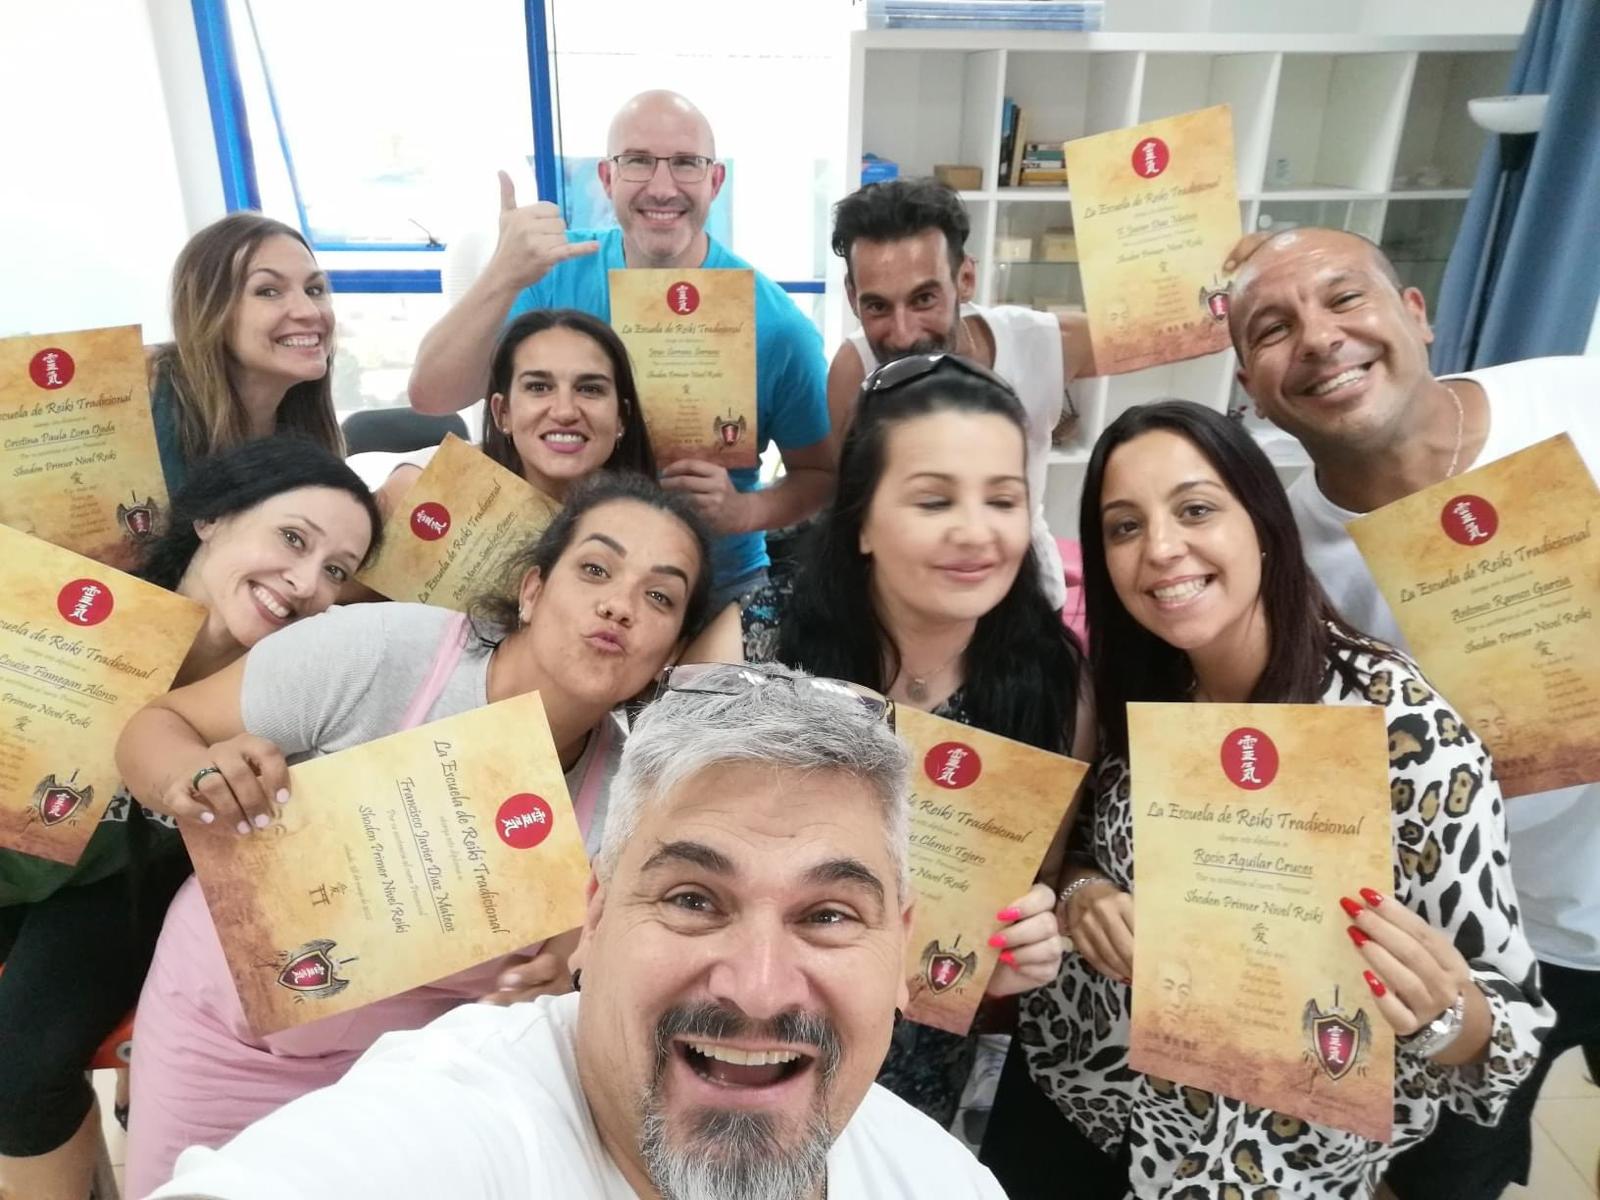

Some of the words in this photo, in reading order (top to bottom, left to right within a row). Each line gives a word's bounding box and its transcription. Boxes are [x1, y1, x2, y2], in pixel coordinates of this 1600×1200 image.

[1082, 206, 1096, 219] La
[1098, 197, 1131, 215] Escuela
[1130, 192, 1142, 206] de
[1170, 175, 1221, 197] Tradicional
[622, 324, 632, 334] La
[634, 322, 662, 333] Escuela
[674, 322, 696, 334] Reiki
[697, 321, 744, 334] Tradicional
[30, 402, 43, 416] de
[45, 398, 74, 414] Reiki
[76, 388, 133, 410] Tradicional
[96, 449, 117, 463] Reiki
[424, 560, 451, 592] Escuela
[444, 548, 458, 563] de
[452, 526, 474, 551] Reiki
[467, 478, 502, 528] Tradicional
[1398, 587, 1416, 603] La
[1416, 568, 1461, 596] Escuela
[1461, 562, 1476, 580] de
[1477, 550, 1513, 574] Reiki
[1513, 520, 1591, 562] Tradicional
[1498, 626, 1532, 644] Primer
[1533, 613, 1562, 633] Nivel
[1561, 605, 1593, 626] Reiki
[28, 626, 49, 642] de
[48, 632, 84, 657] Reiki
[85, 644, 160, 682] Tradicional
[31, 665, 82, 694] Finnegan
[81, 681, 119, 704] Alonso
[36, 702, 69, 721] Nivel
[64, 710, 92, 729] Reiki
[433, 738, 453, 758] La
[440, 759, 471, 807] Escuela
[358, 805, 381, 842] Shoden
[455, 808, 476, 824] de
[918, 798, 956, 820] Reiki
[956, 808, 1033, 844] Tradicional
[1147, 801, 1164, 817] La
[1168, 802, 1214, 821] Escuela
[1217, 806, 1232, 824] de
[1236, 808, 1274, 829] Reiki
[1277, 812, 1362, 836] Tradicional
[370, 842, 388, 878] Primer
[400, 777, 423, 831] Francisco
[412, 830, 433, 866] Javier
[435, 892, 455, 934] Mateos
[461, 826, 487, 861] Reiki
[1226, 852, 1273, 875] Aguilar
[1275, 857, 1314, 875] Cruces
[381, 878, 404, 908] Nivel
[473, 862, 511, 933] Tradicional
[943, 873, 970, 893] Reiki
[390, 906, 412, 934] Reiki
[1184, 888, 1221, 906] Shoden
[1223, 896, 1260, 912] Primer
[1262, 901, 1292, 917] Nivel
[1293, 906, 1324, 924] Reiki
